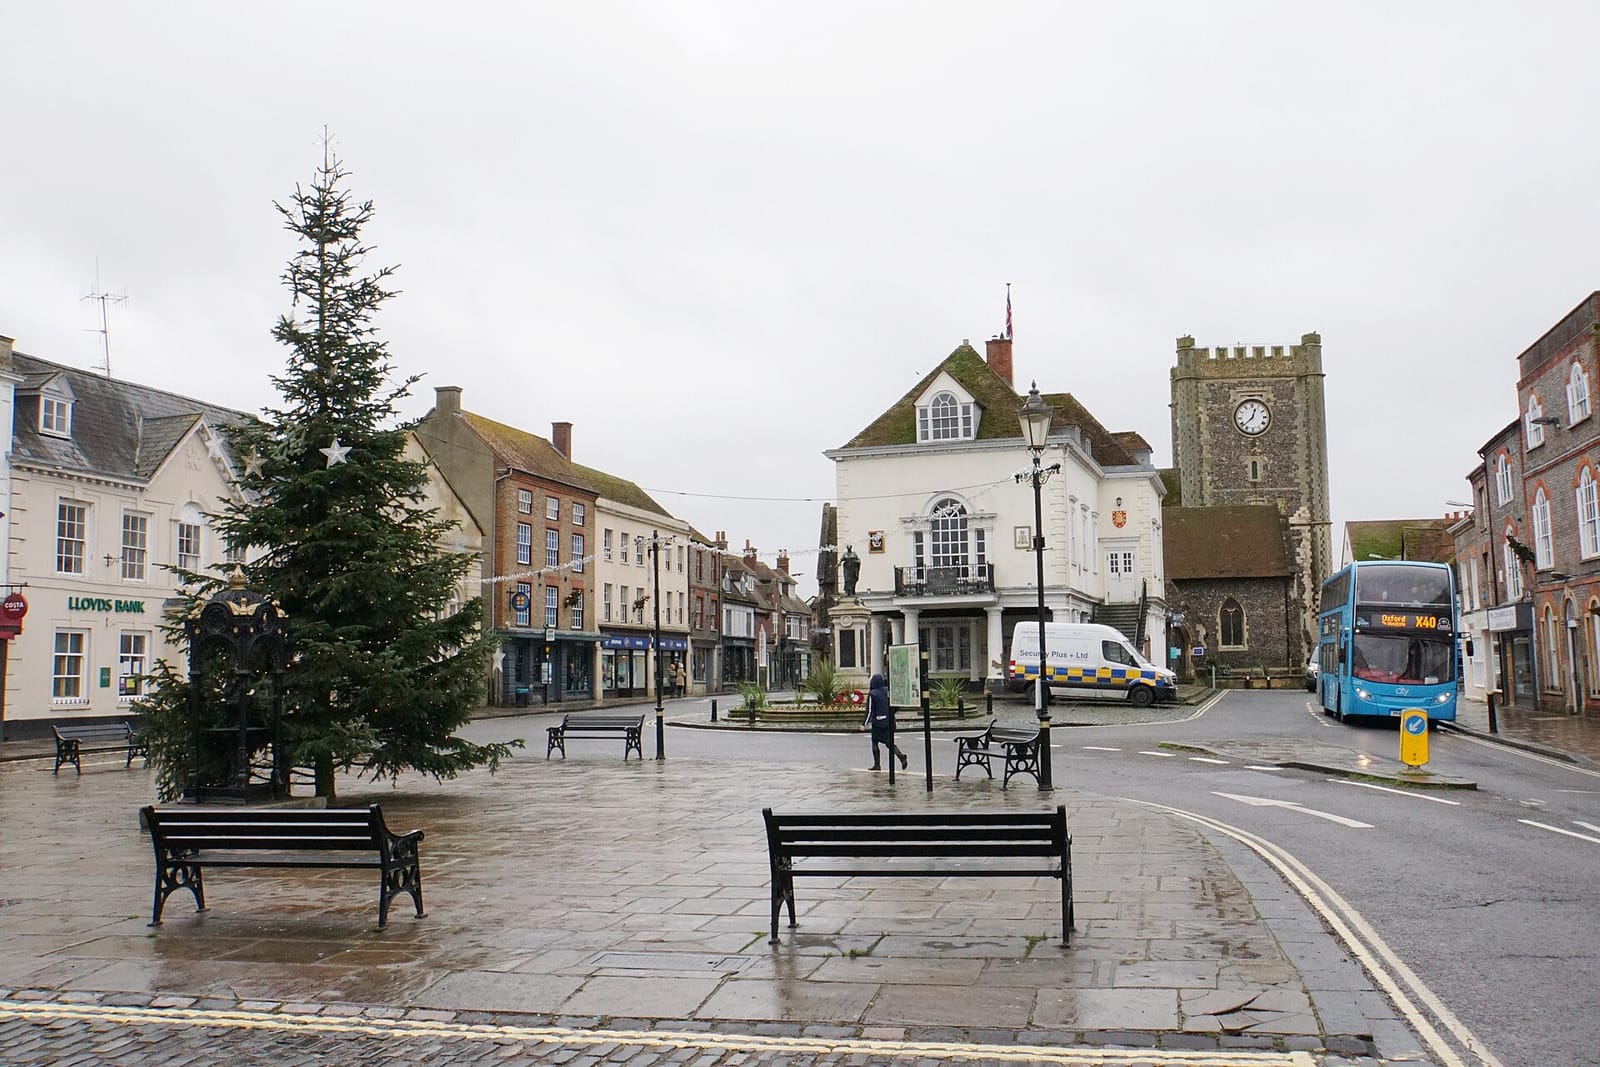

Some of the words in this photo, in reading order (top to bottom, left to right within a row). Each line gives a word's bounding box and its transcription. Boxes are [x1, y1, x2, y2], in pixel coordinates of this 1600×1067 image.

[68, 596, 113, 612] LLOYDS
[115, 600, 145, 613] BANK
[1381, 614, 1406, 622] Oxford
[1415, 616, 1437, 628] X40
[1020, 650, 1050, 658] Secury
